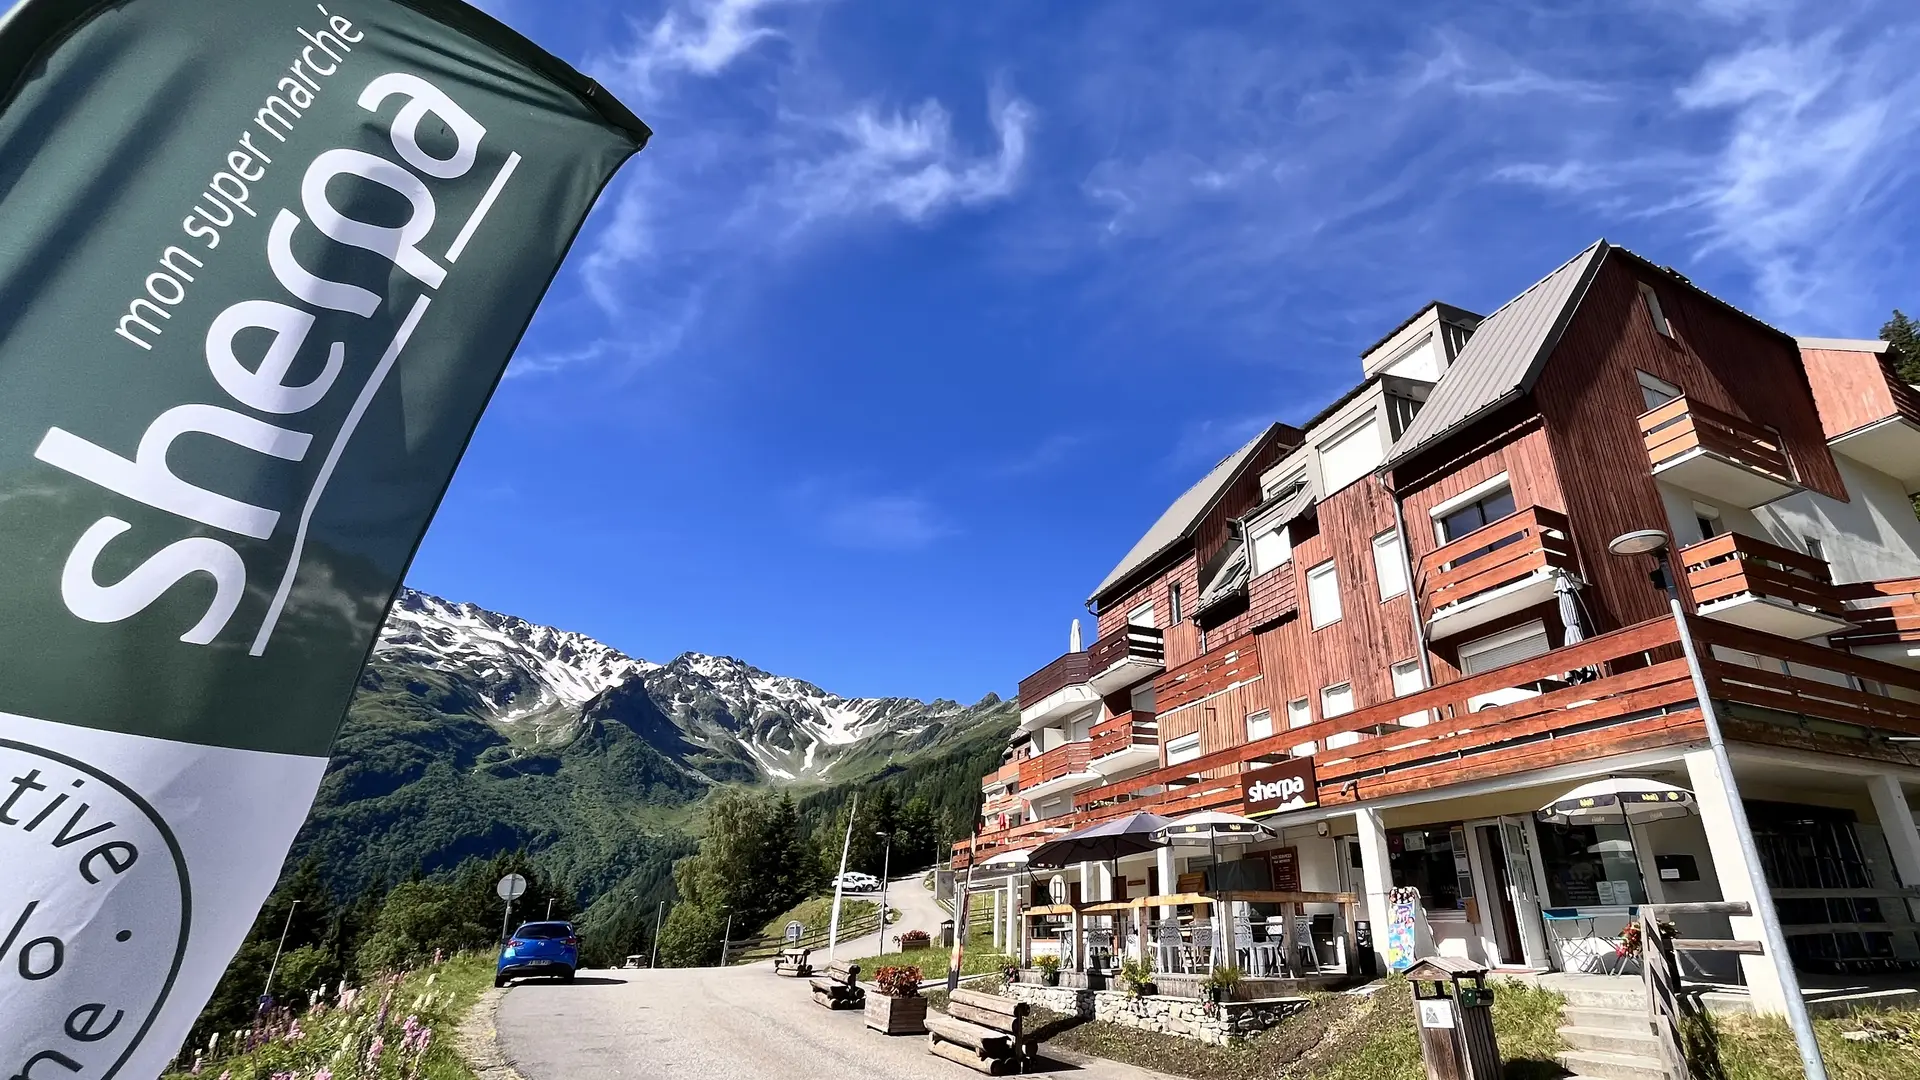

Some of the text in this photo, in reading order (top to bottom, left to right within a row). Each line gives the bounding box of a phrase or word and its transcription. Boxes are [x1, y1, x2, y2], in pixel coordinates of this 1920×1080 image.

[114, 4, 364, 351] mon super marché
[33, 72, 488, 646] sherpa
[1248, 776, 1305, 803] sherpa
